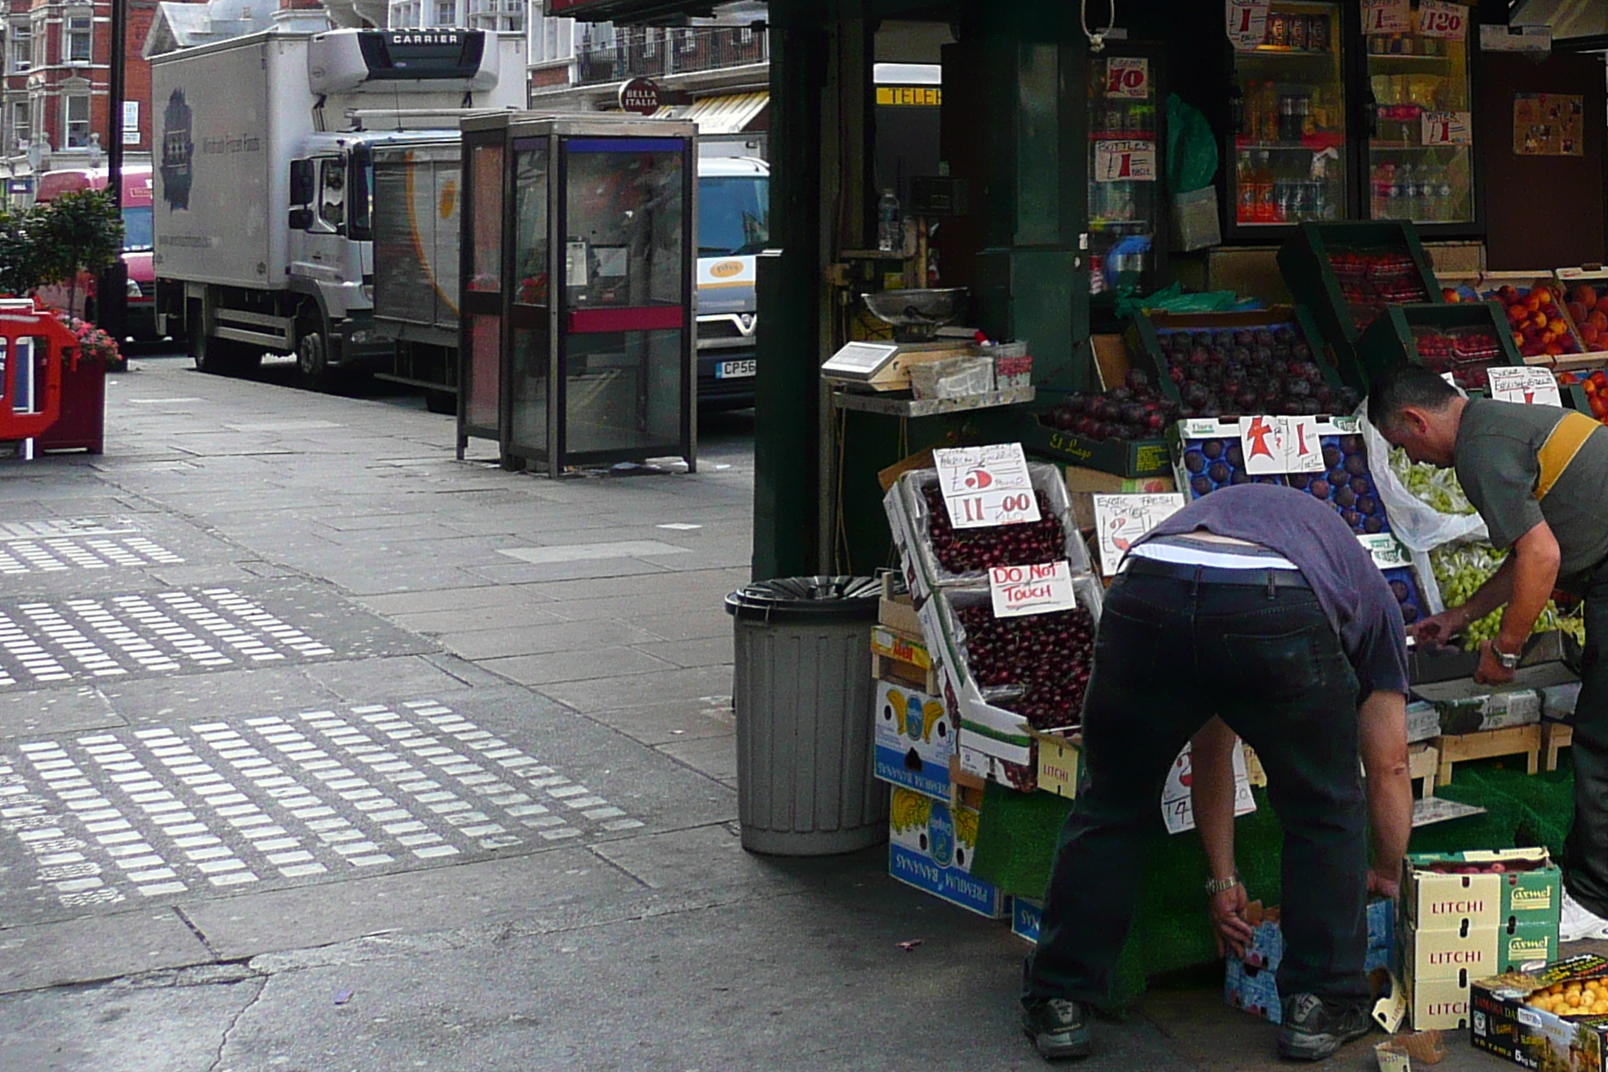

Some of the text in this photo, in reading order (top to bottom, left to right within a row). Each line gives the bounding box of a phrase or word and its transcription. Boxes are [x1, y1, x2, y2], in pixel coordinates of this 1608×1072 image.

[393, 35, 457, 43] CARRIER
[626, 90, 656, 98] BELLA
[626, 98, 658, 106] ITALIA
[1141, 495, 1174, 505] FRESH
[993, 567, 1022, 584] DO
[1003, 585, 1052, 602] TOUCH
[1043, 764, 1069, 782] LITCHI
[896, 856, 988, 903] PREMIUM BANANAS
[1511, 885, 1552, 900] Carmel
[1432, 900, 1483, 914] LITCHI
[1509, 935, 1549, 950] Carmel
[1430, 950, 1482, 965] LITCHI
